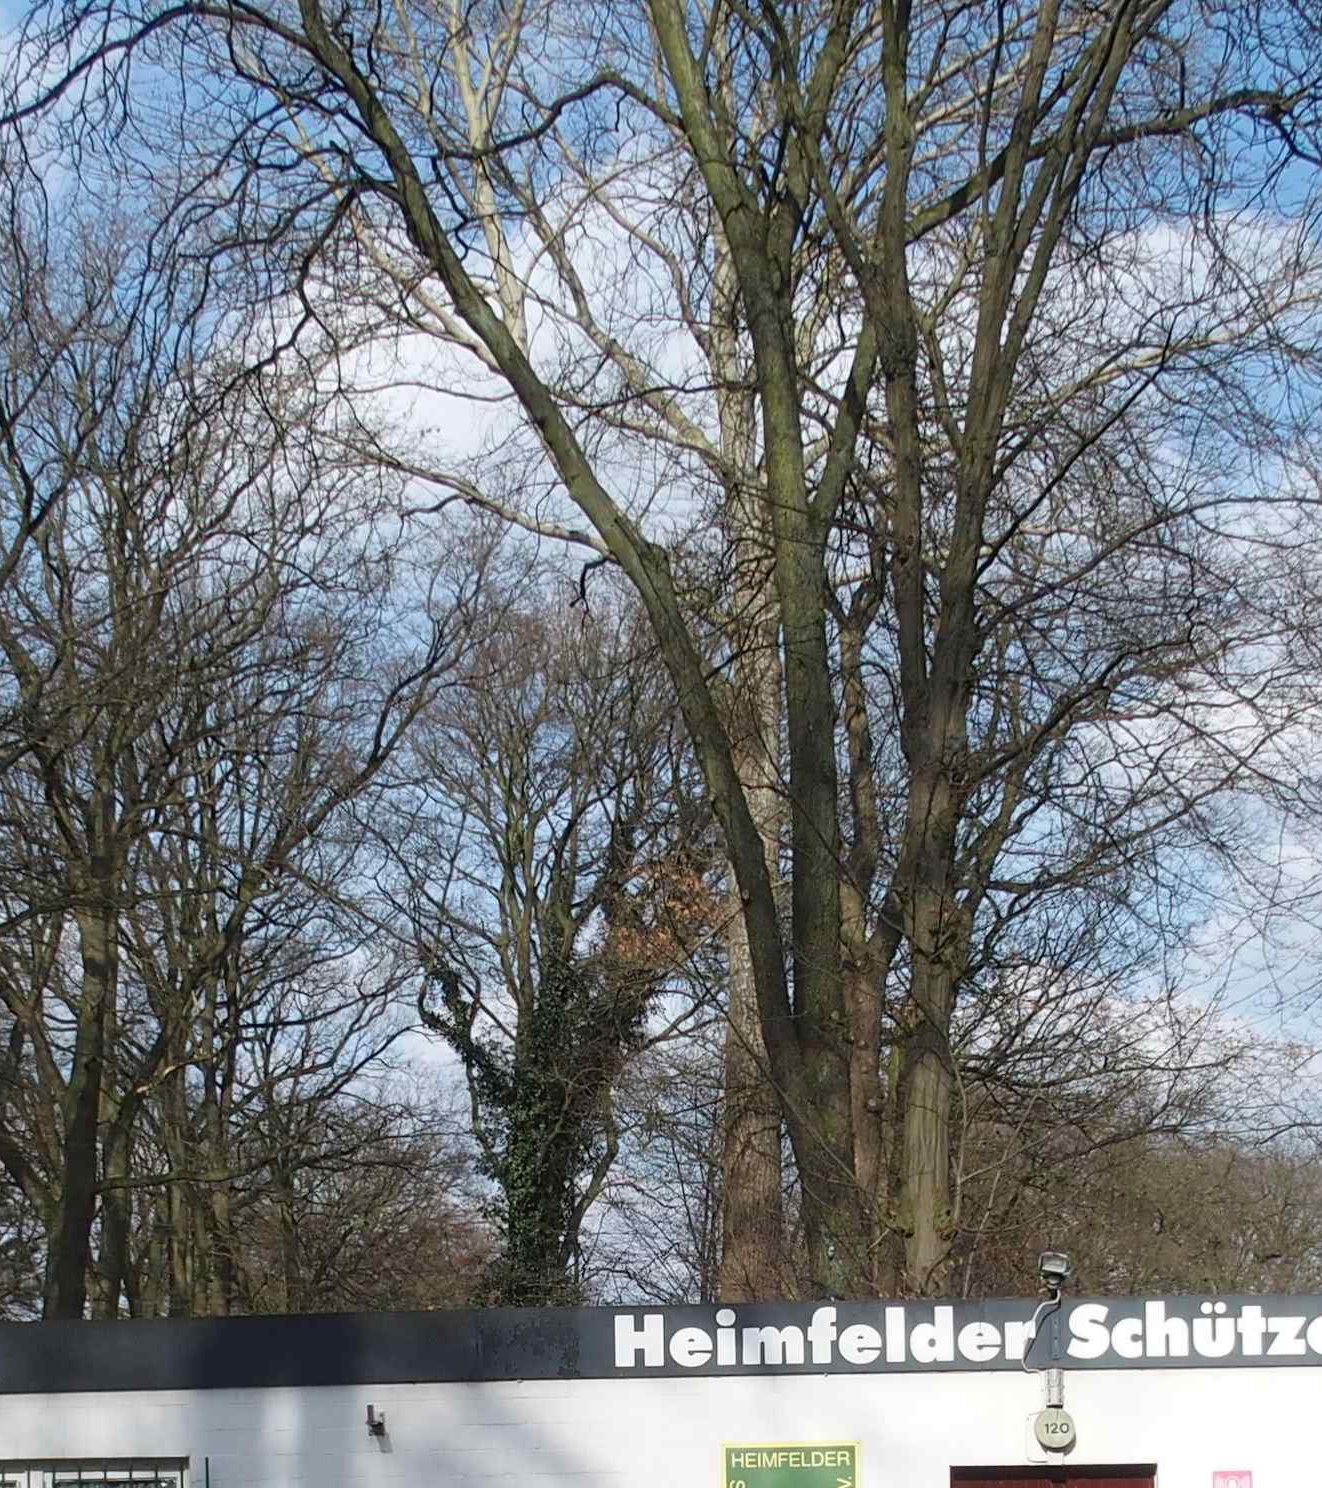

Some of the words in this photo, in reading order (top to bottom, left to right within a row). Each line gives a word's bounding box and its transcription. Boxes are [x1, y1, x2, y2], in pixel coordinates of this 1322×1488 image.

[614, 1306, 1036, 1368] Heimfelder
[1044, 1422, 1070, 1434] 120
[731, 1450, 850, 1468] HEIMFELDER
